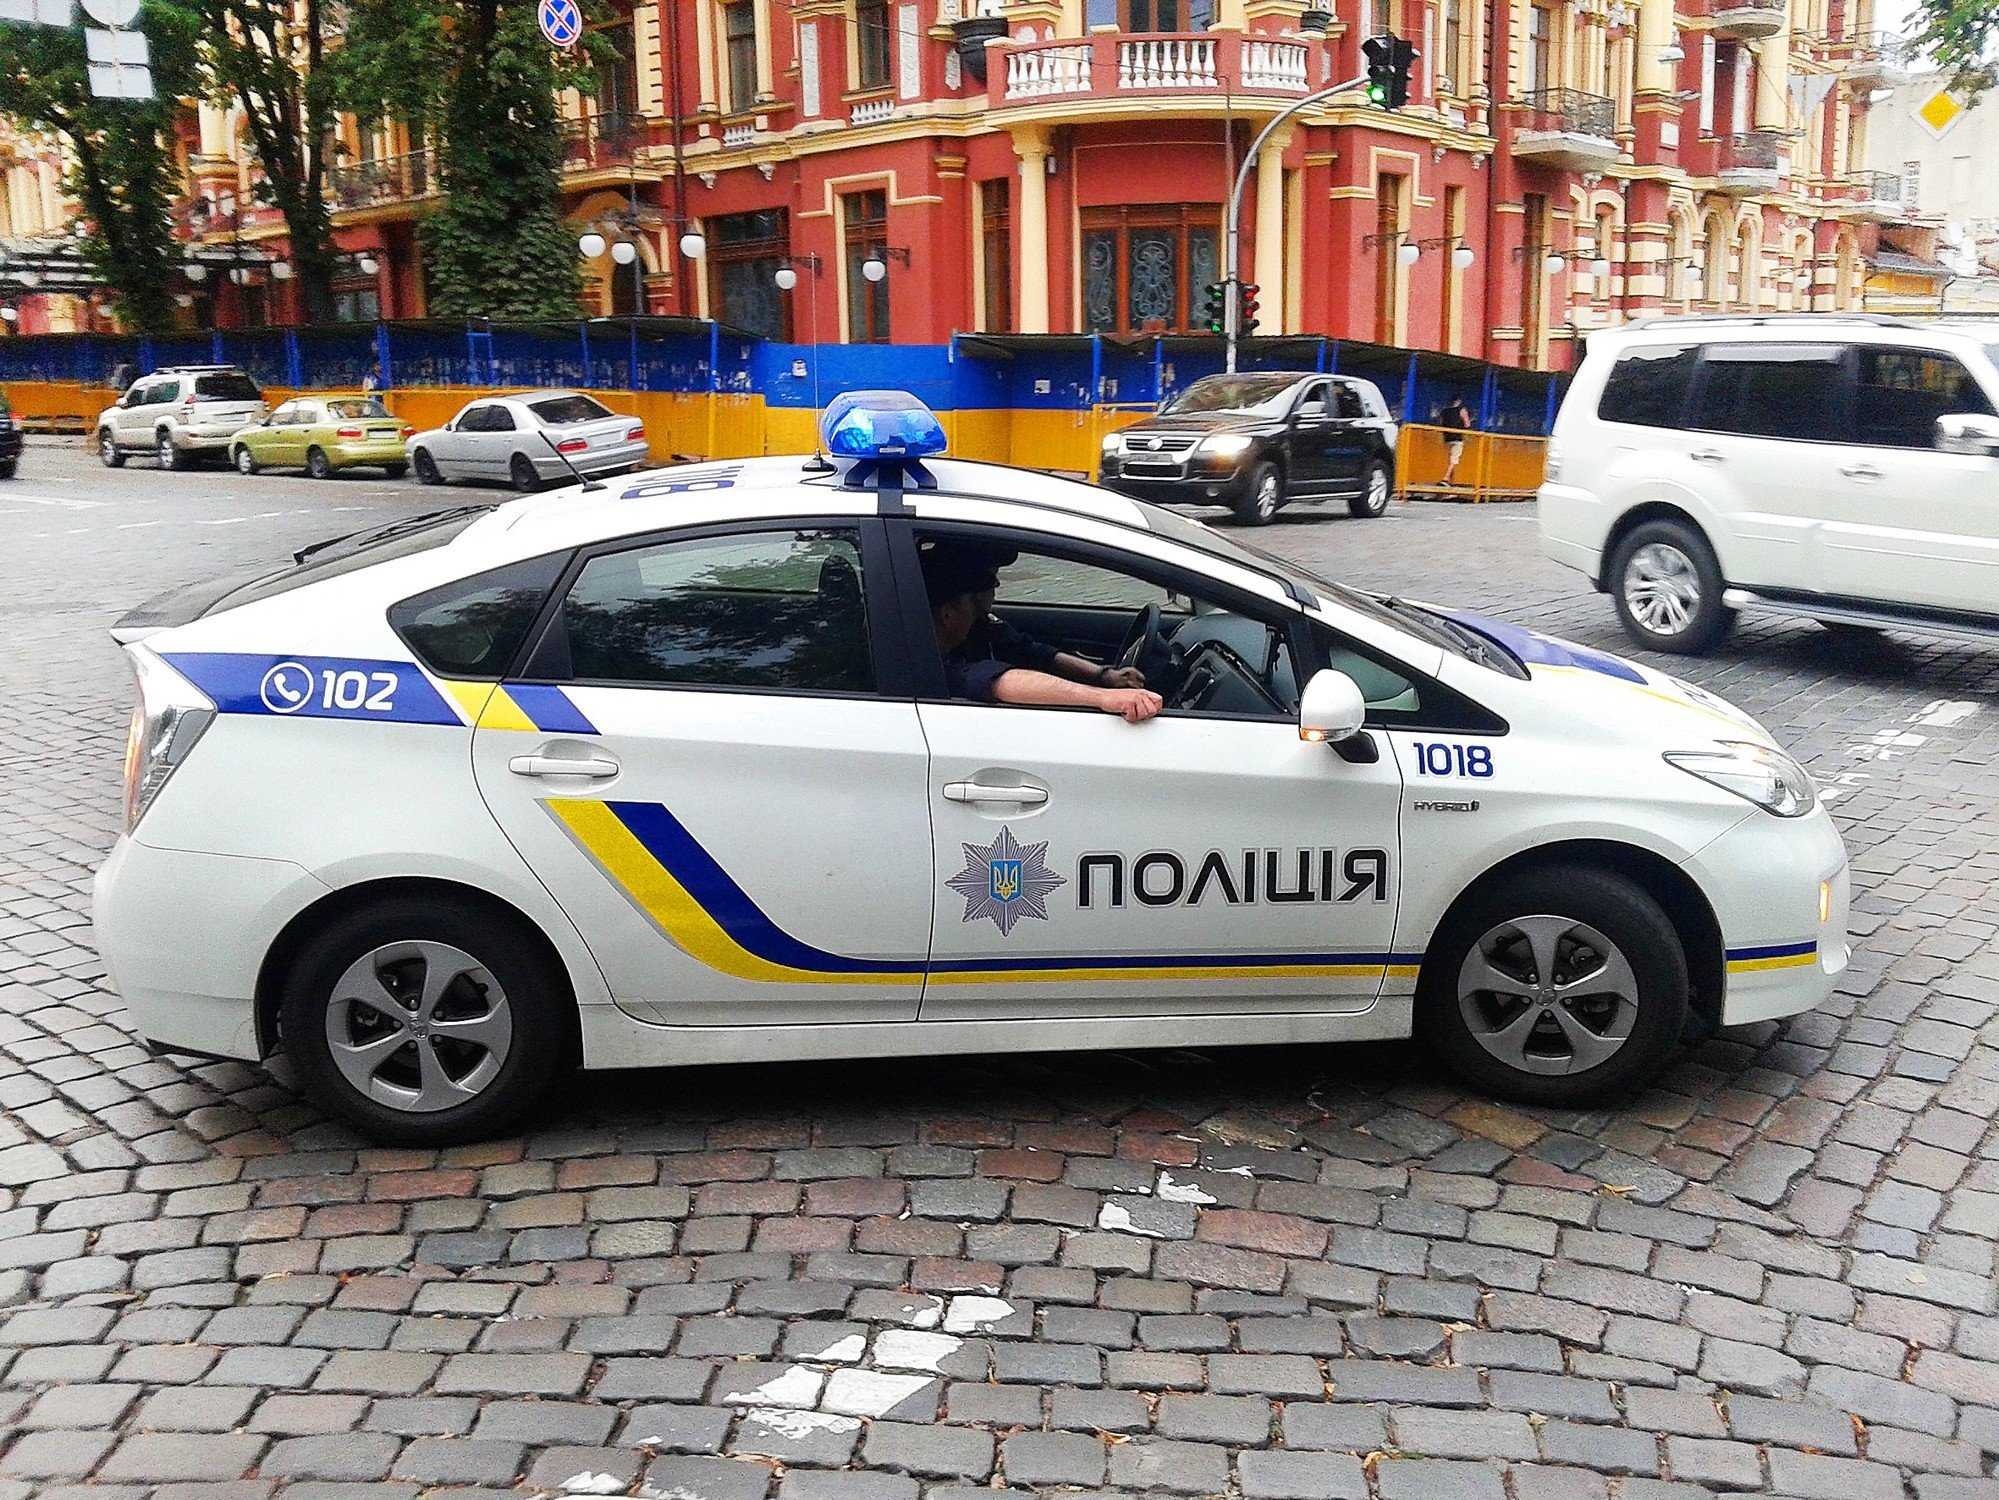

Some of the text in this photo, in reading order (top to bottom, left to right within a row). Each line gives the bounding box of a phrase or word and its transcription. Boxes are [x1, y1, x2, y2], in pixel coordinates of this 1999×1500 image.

[322, 669, 398, 711] 102
[1412, 742, 1494, 777] 1018
[1078, 848, 1388, 907] ПОЛІЦІЯ
